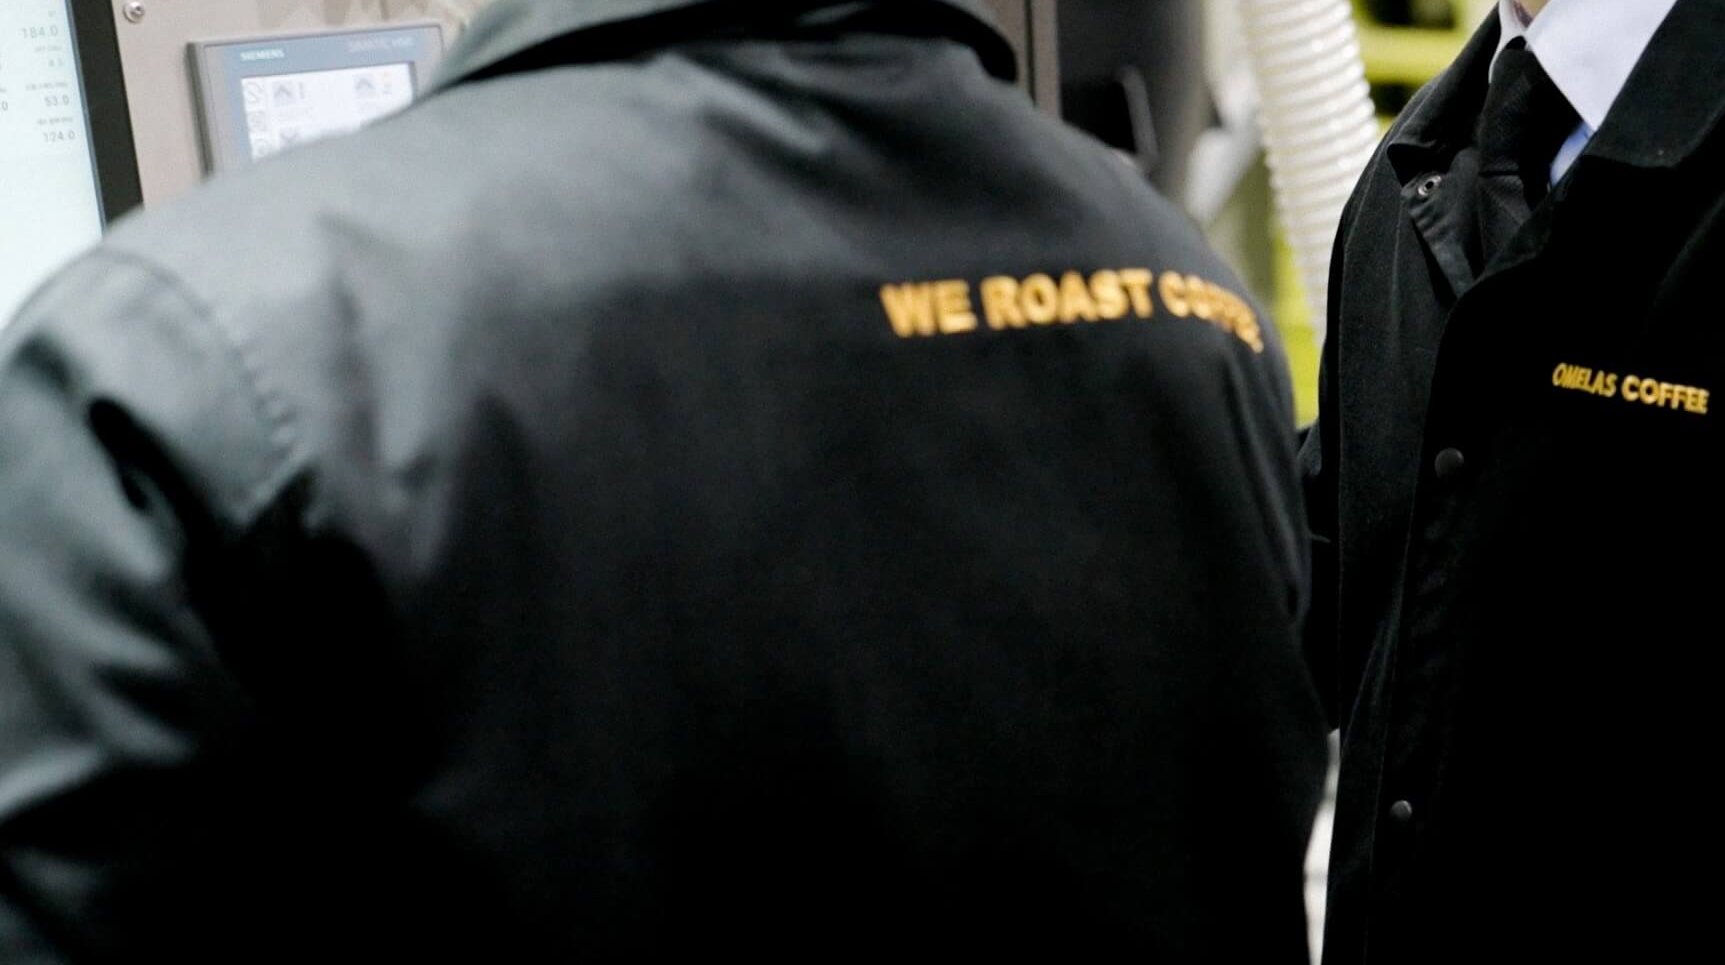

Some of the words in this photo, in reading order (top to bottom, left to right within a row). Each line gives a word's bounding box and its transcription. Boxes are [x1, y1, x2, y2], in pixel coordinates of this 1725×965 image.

[879, 279, 978, 338] WE
[980, 267, 1153, 331] ROAST
[1552, 362, 1617, 397] OMELAS
[1621, 374, 1710, 415] COFFEE
